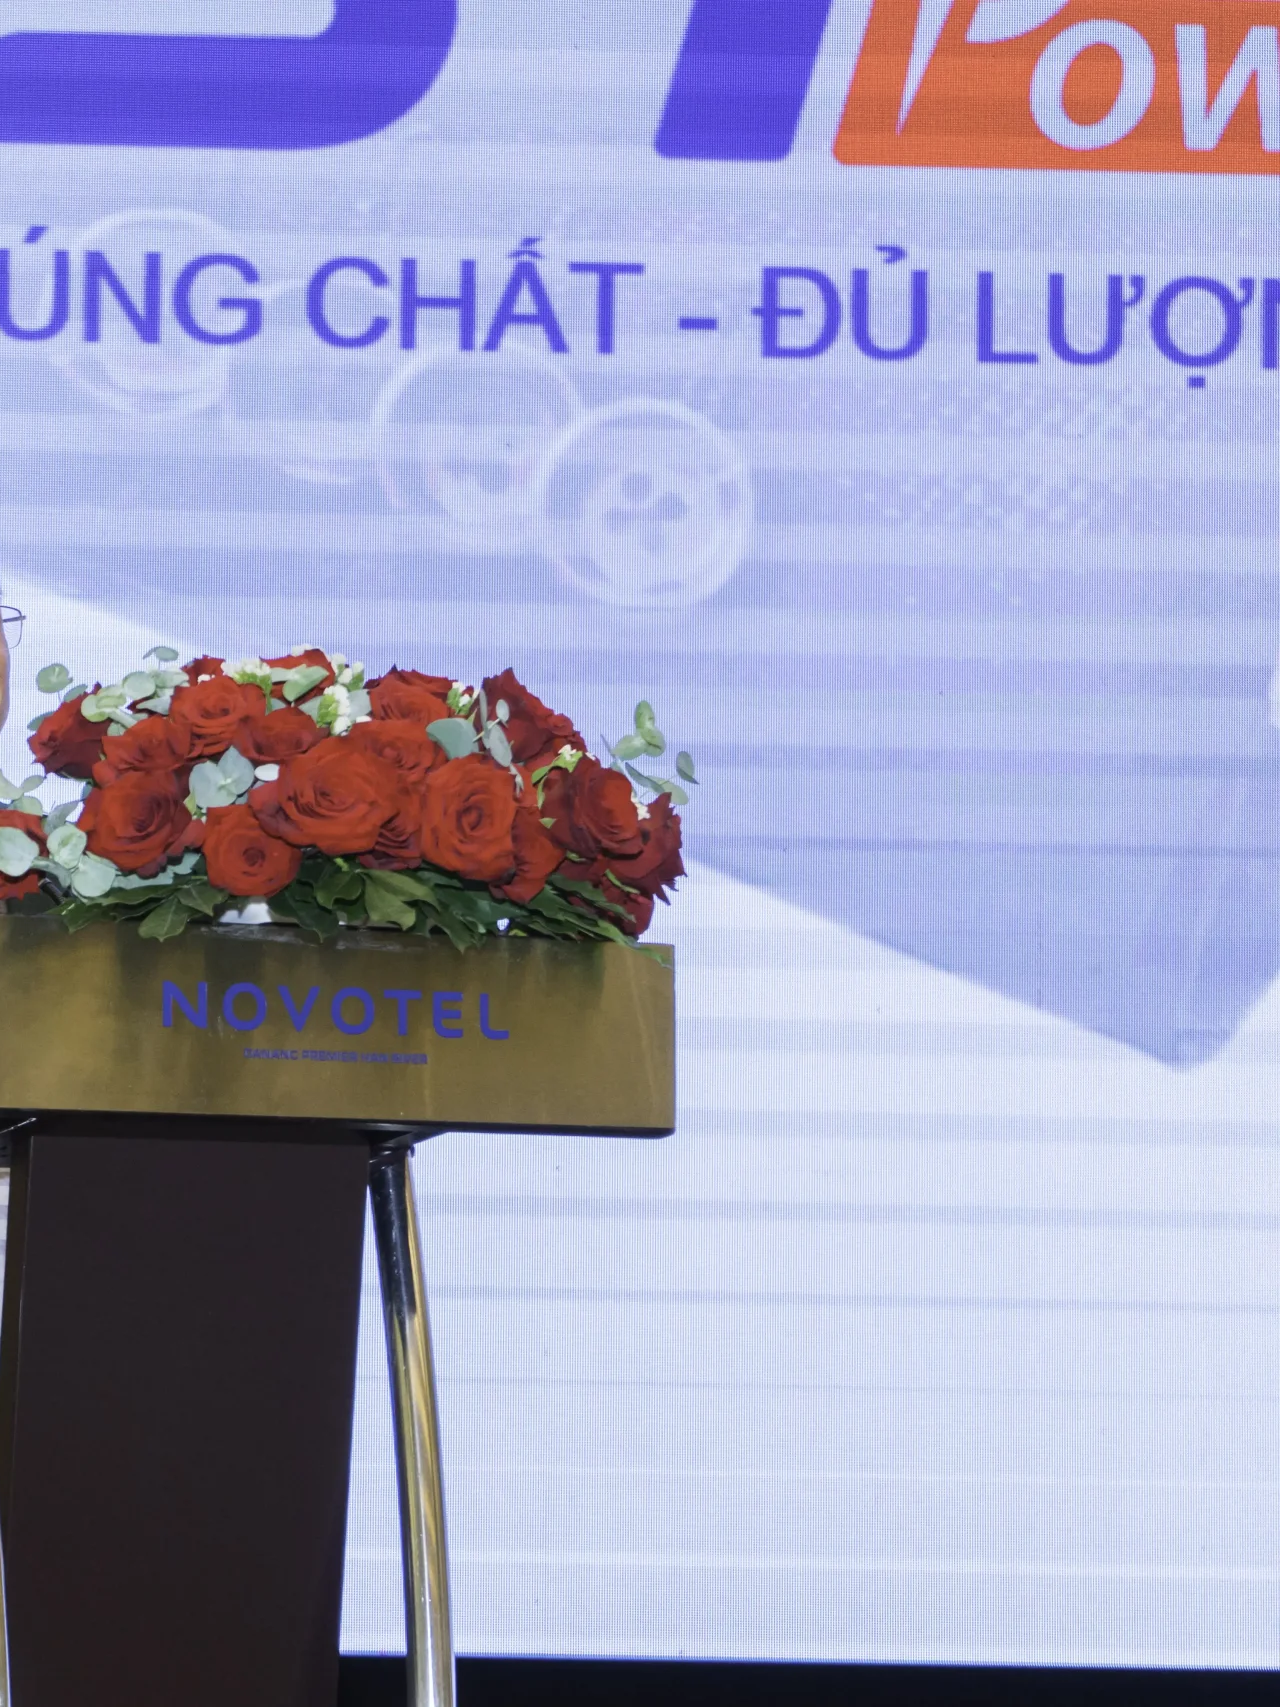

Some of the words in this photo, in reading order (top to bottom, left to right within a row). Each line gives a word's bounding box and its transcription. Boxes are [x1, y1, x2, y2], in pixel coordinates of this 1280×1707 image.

[305, 236, 645, 356] CHẤT
[750, 244, 929, 362] ĐỦ
[976, 270, 1280, 389] LƯỢ
[162, 980, 510, 1040] NOVOTEL
